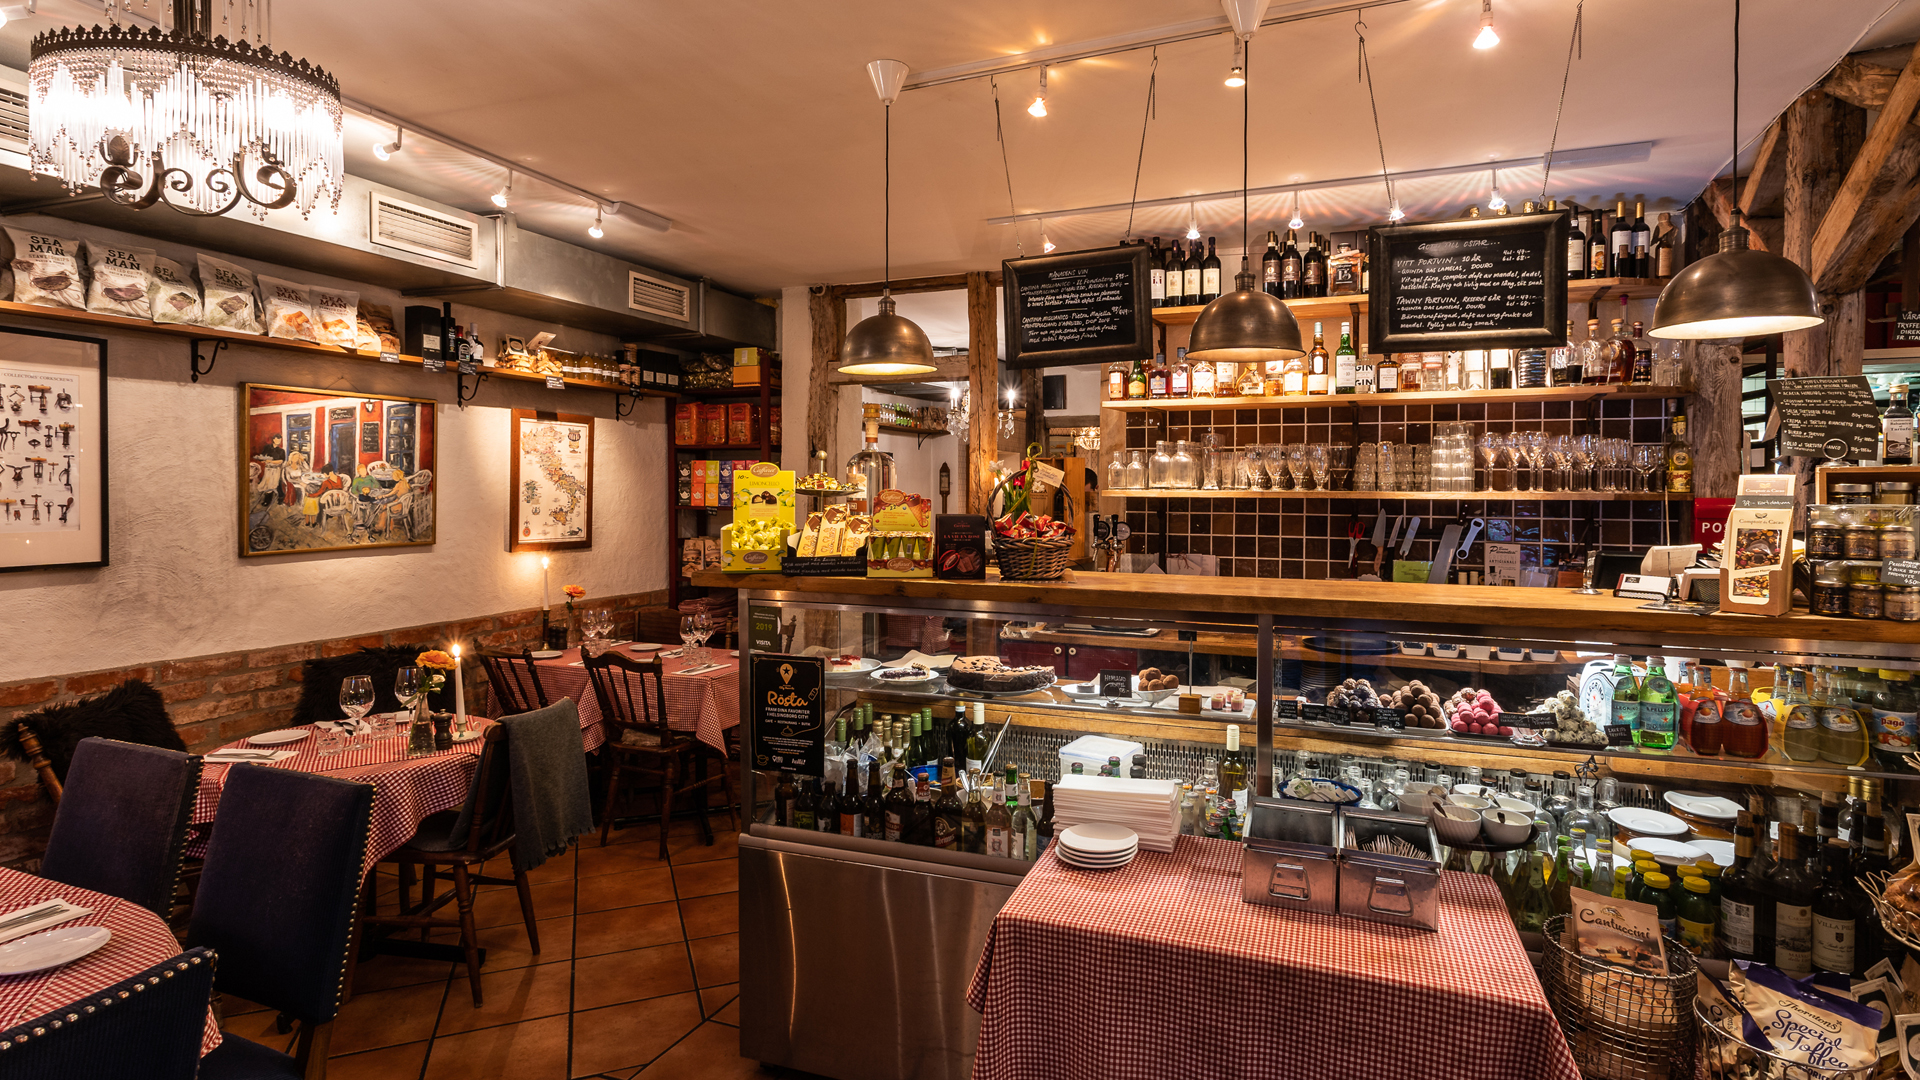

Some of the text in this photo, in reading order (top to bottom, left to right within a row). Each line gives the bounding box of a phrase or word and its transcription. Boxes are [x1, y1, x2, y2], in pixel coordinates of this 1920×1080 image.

[30, 236, 62, 247] SEA
[29, 244, 65, 256] MAN
[107, 249, 137, 262] SEA
[105, 257, 141, 271] MAN
[1397, 259, 1415, 268] VITT
[1418, 257, 1457, 266] PORTVIN,
[1471, 253, 1482, 262] ÅR
[154, 266, 176, 279] SEA
[216, 268, 239, 280] SEA
[215, 273, 243, 287] MAN
[276, 286, 299, 295] SEA
[276, 291, 303, 302] MAN
[320, 299, 347, 309] MAN
[321, 294, 344, 303] SEA
[1396, 296, 1423, 305] TAWNY
[1424, 296, 1460, 304] PORTVIN,
[1702, 522, 1727, 534] PO
[755, 622, 773, 631] 2019
[767, 691, 808, 707] Rösta
[1881, 717, 1905, 727] pago
[1580, 908, 1651, 940] Cantuccini
[1816, 919, 1839, 930] VILLA
[1778, 1000, 1838, 1031] Thorntons
[1771, 1009, 1842, 1050] Special
[1787, 1031, 1849, 1070] Toffee
